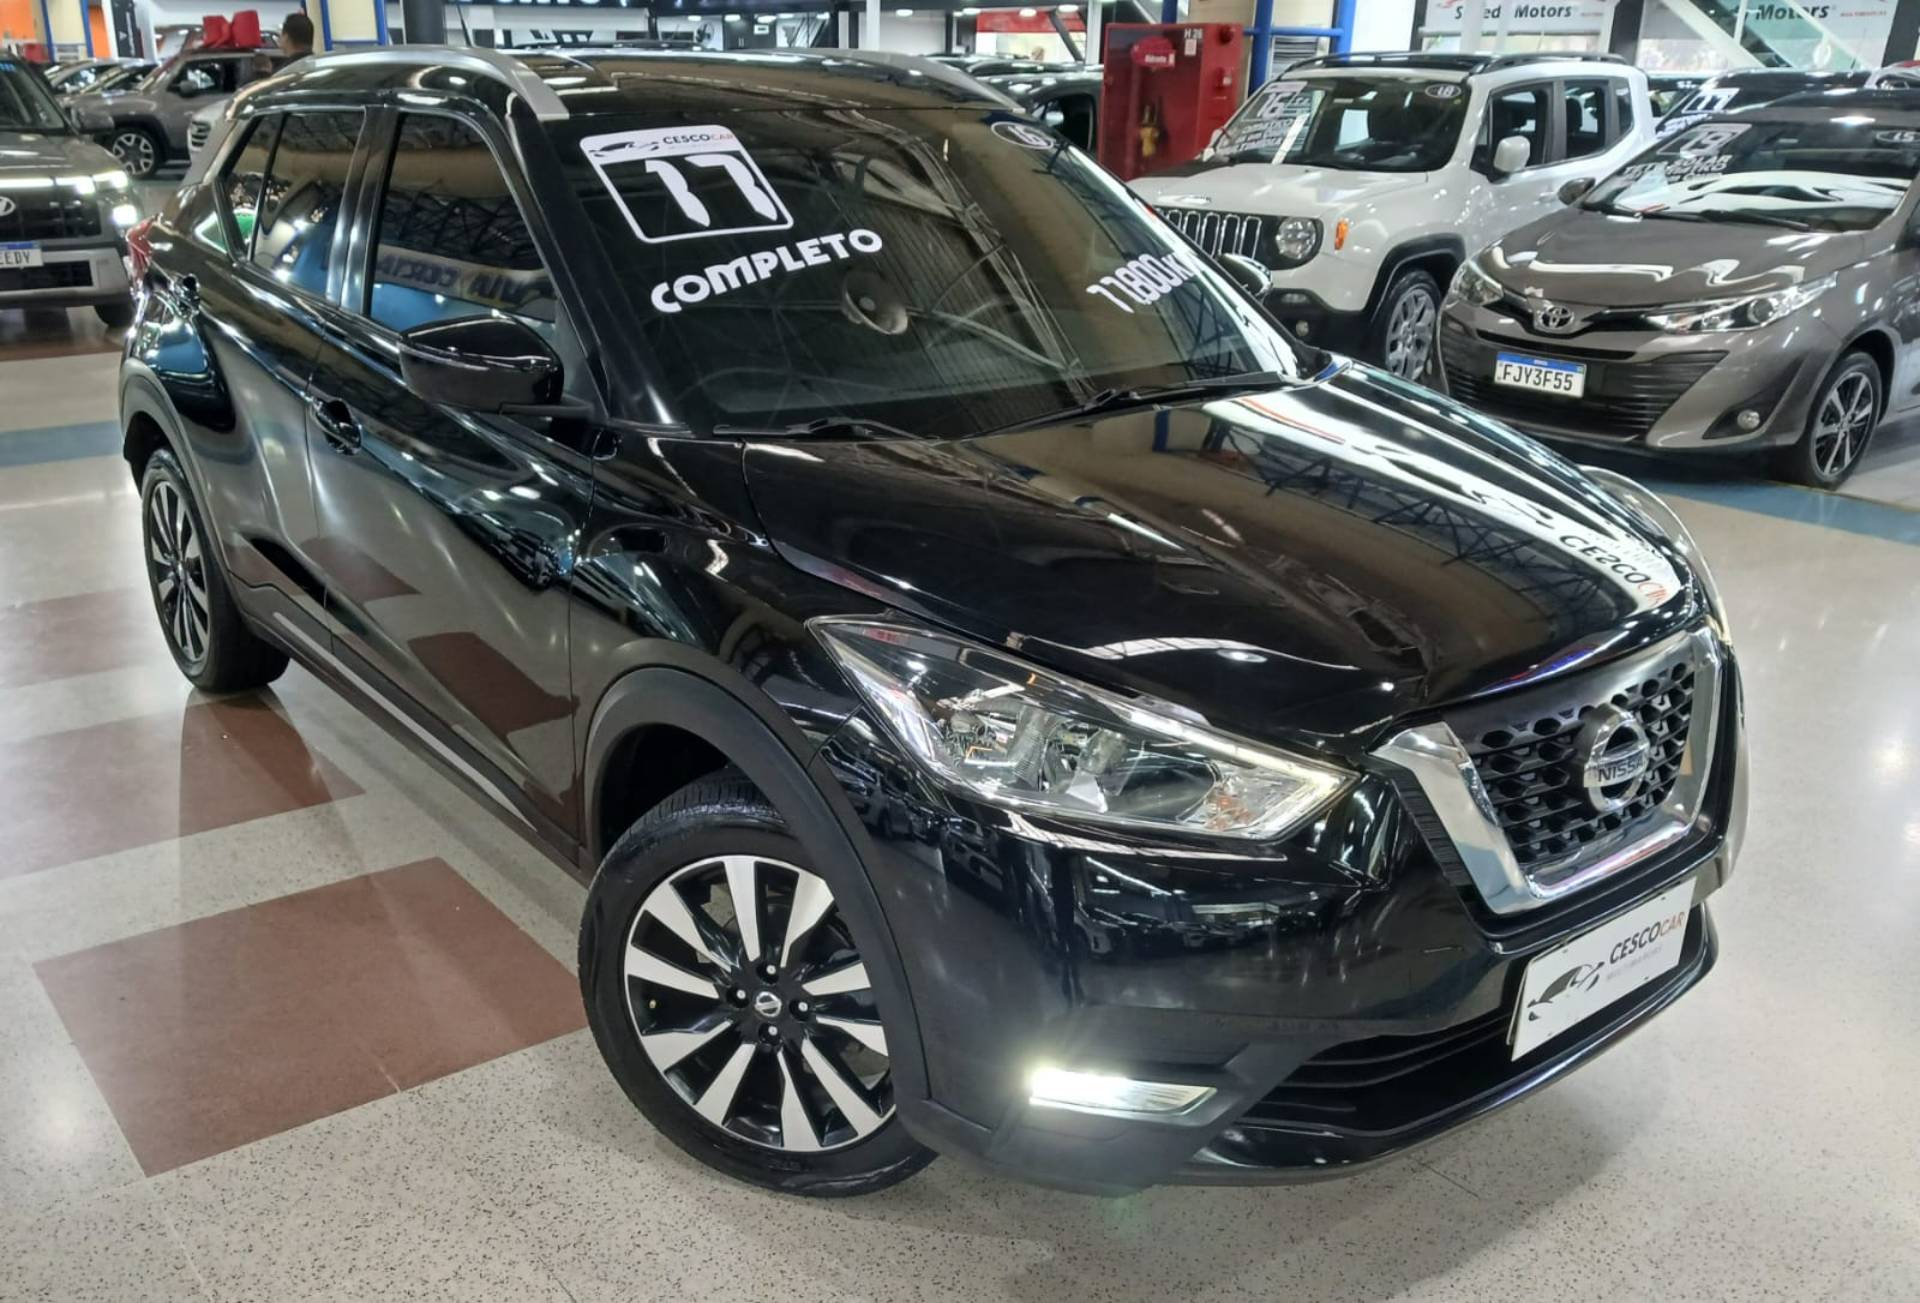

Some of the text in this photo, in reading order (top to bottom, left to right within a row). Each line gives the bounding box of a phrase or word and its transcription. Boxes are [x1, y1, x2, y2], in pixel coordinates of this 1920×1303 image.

[1514, 5, 1572, 18] Motors
[650, 229, 883, 314] COMPLETO
[1502, 364, 1574, 392] FJY3F55
[1610, 911, 1686, 965] CESCOCAR
